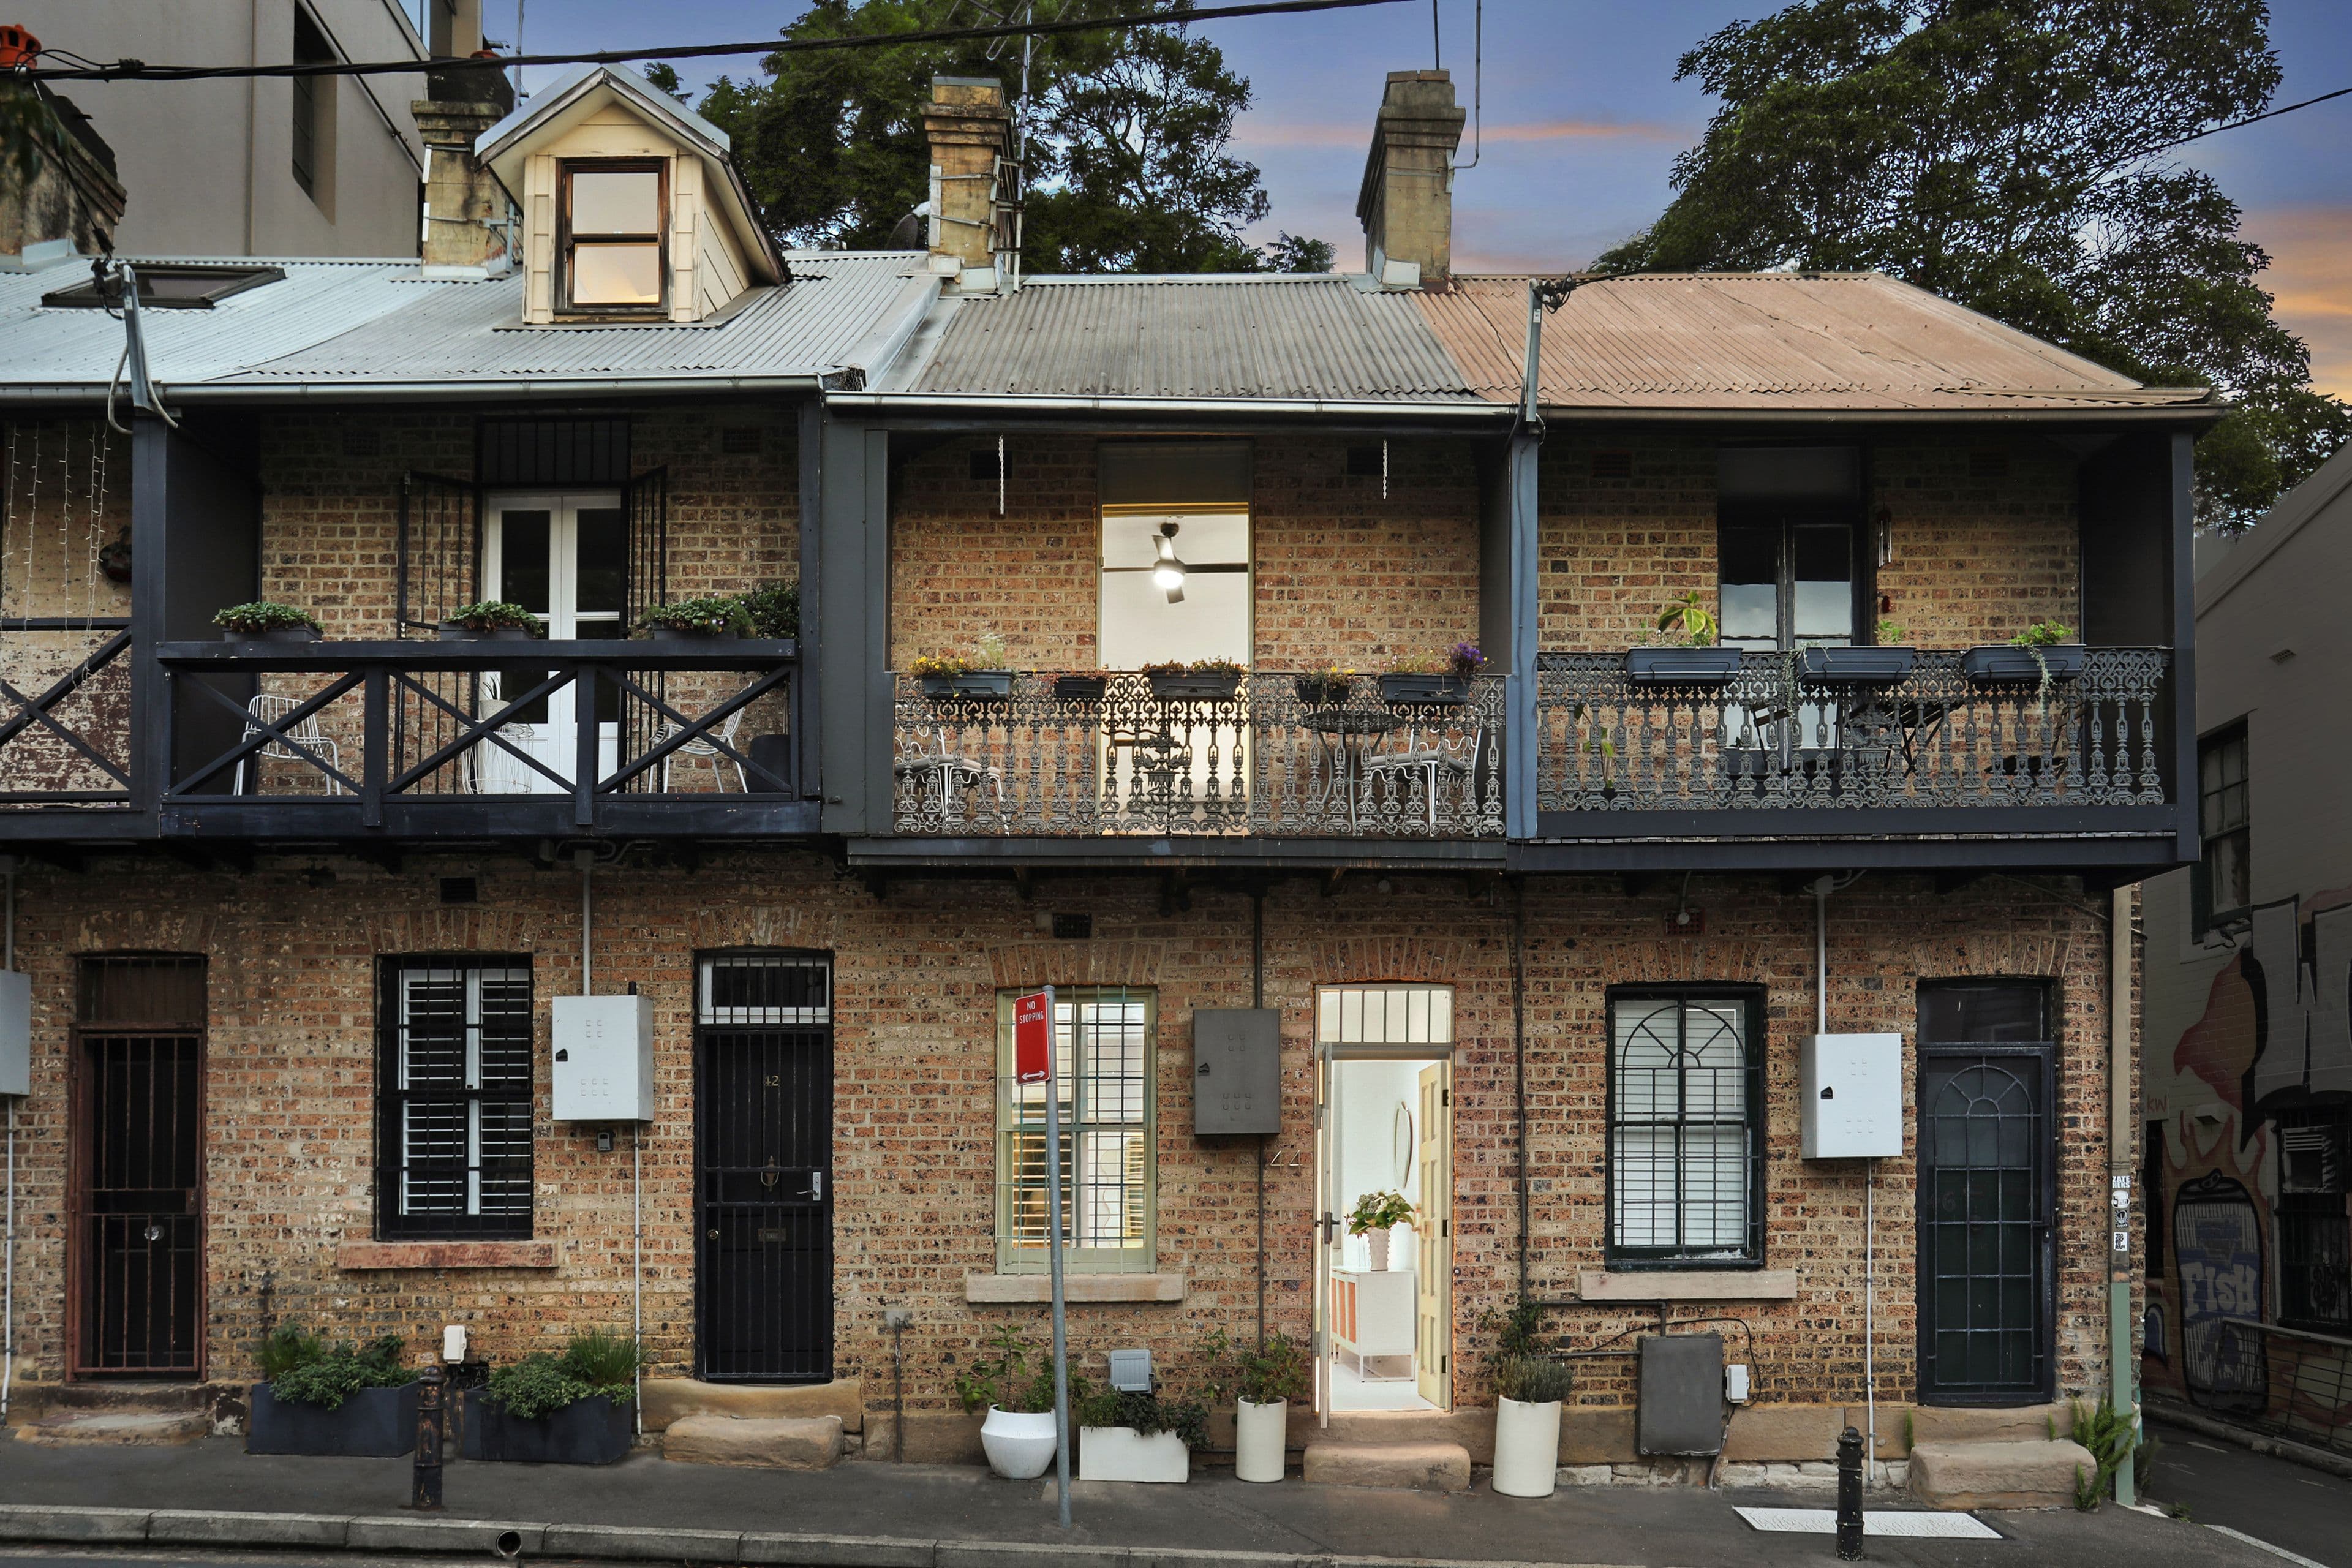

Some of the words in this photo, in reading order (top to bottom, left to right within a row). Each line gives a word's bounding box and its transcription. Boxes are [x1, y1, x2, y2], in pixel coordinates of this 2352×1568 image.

[1027, 1001, 1035, 1011] NO
[1019, 1011, 1044, 1024] STOPPING
[764, 1075, 779, 1087] 42
[1270, 1150, 1303, 1172] 44
[2180, 1262, 2258, 1319] FISH
